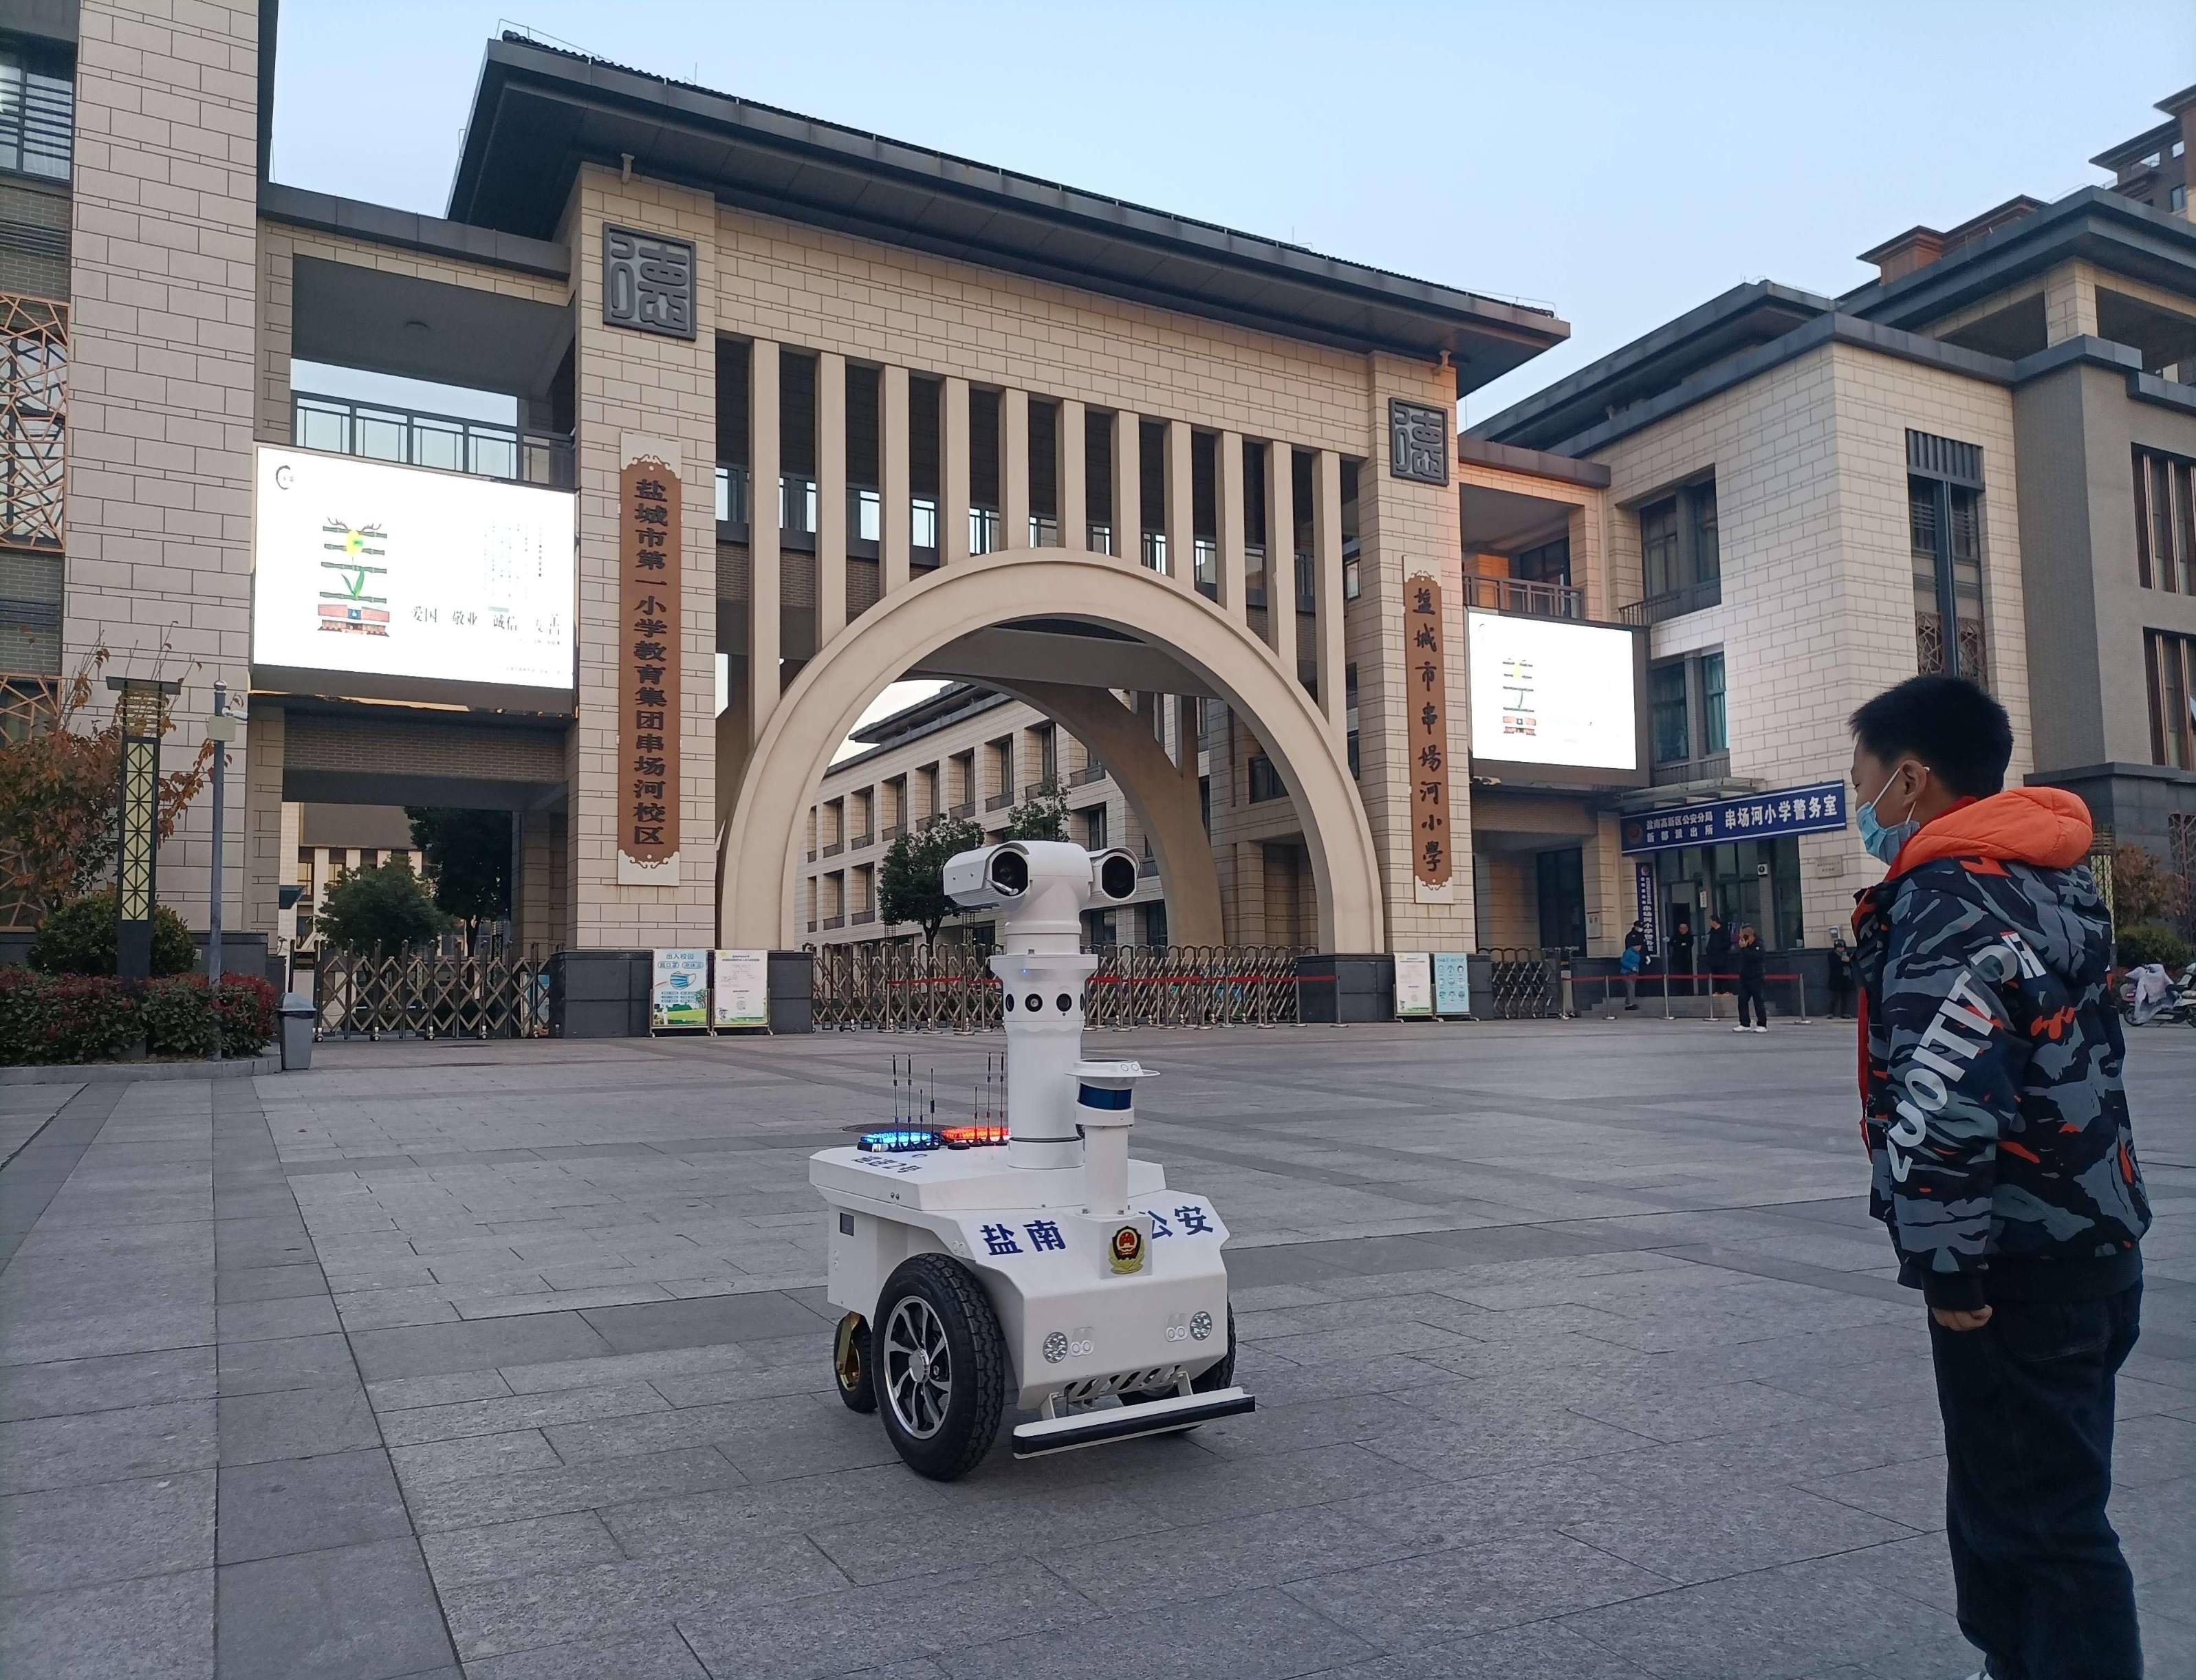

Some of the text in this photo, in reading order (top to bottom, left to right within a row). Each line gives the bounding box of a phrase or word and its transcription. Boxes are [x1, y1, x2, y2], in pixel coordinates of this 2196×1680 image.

[633, 479, 668, 845] 盐城市第一小学教育集团串场河校区
[1725, 794, 1838, 829] 串场河小学警务室
[979, 1206, 1214, 1256] 盐南 公安
